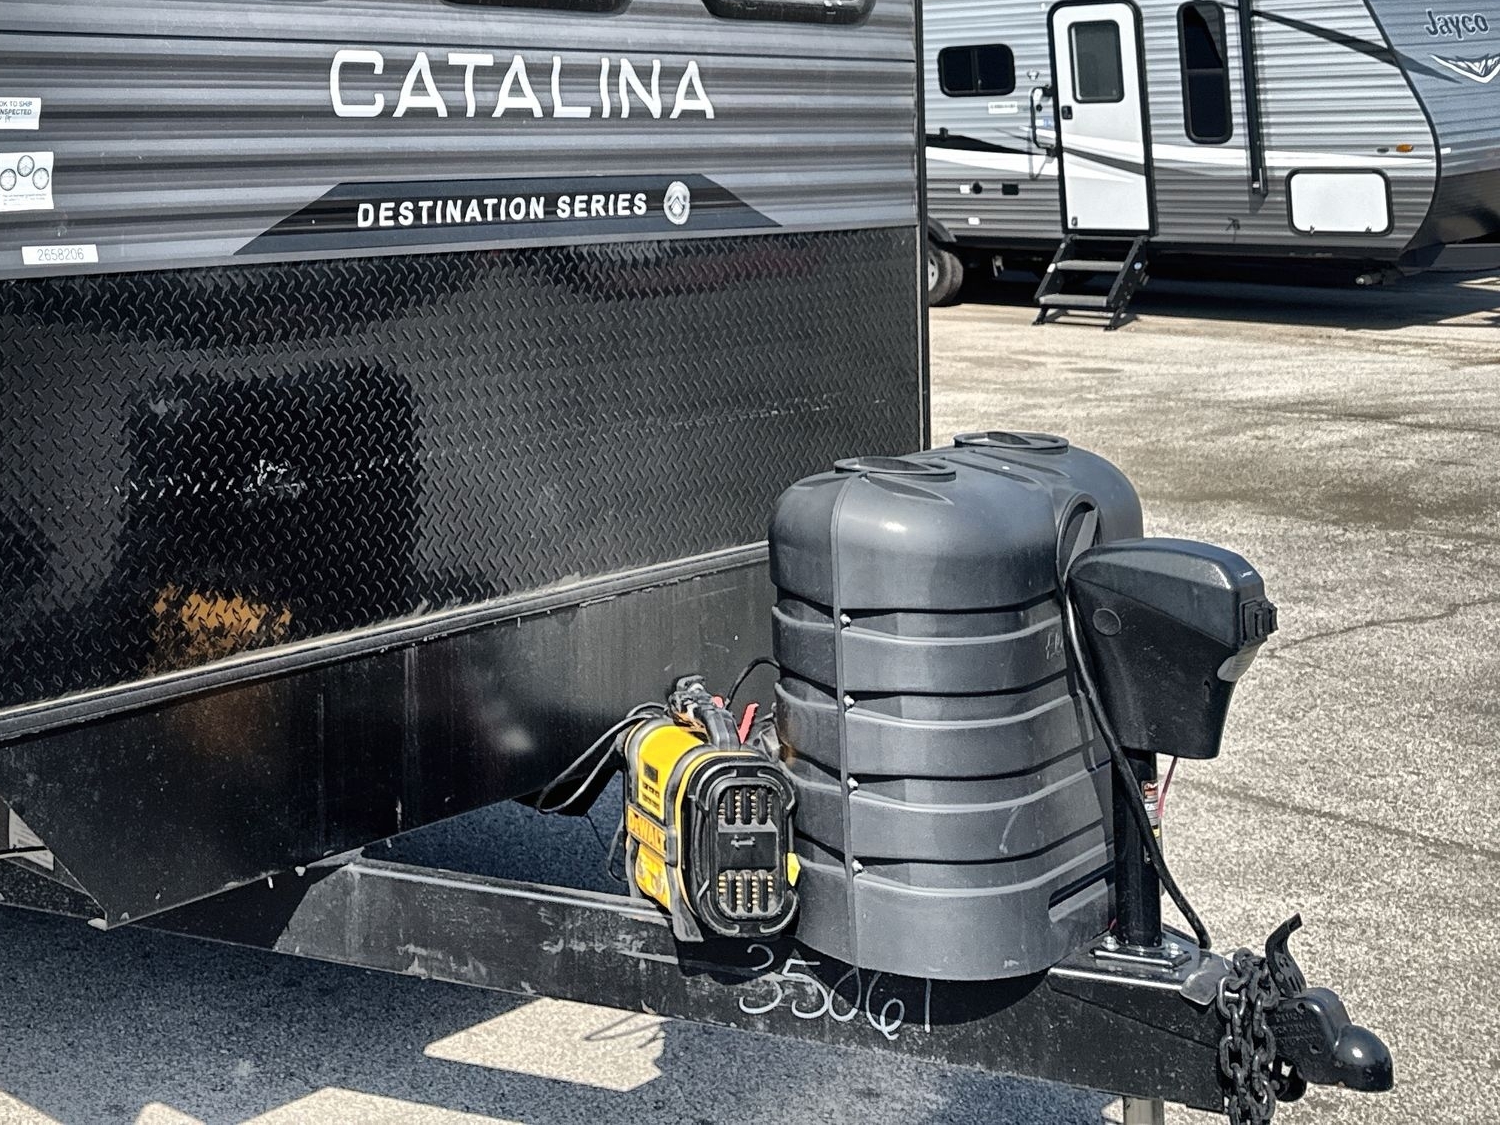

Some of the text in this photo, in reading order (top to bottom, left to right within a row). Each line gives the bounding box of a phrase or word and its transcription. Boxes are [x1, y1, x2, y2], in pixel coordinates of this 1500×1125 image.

[1425, 8, 1490, 41] Jayco
[329, 49, 715, 119] CATALINA
[357, 192, 647, 228] DESTINATION SERIES
[37, 248, 84, 261] 2658206
[738, 943, 932, 1041] 35061
